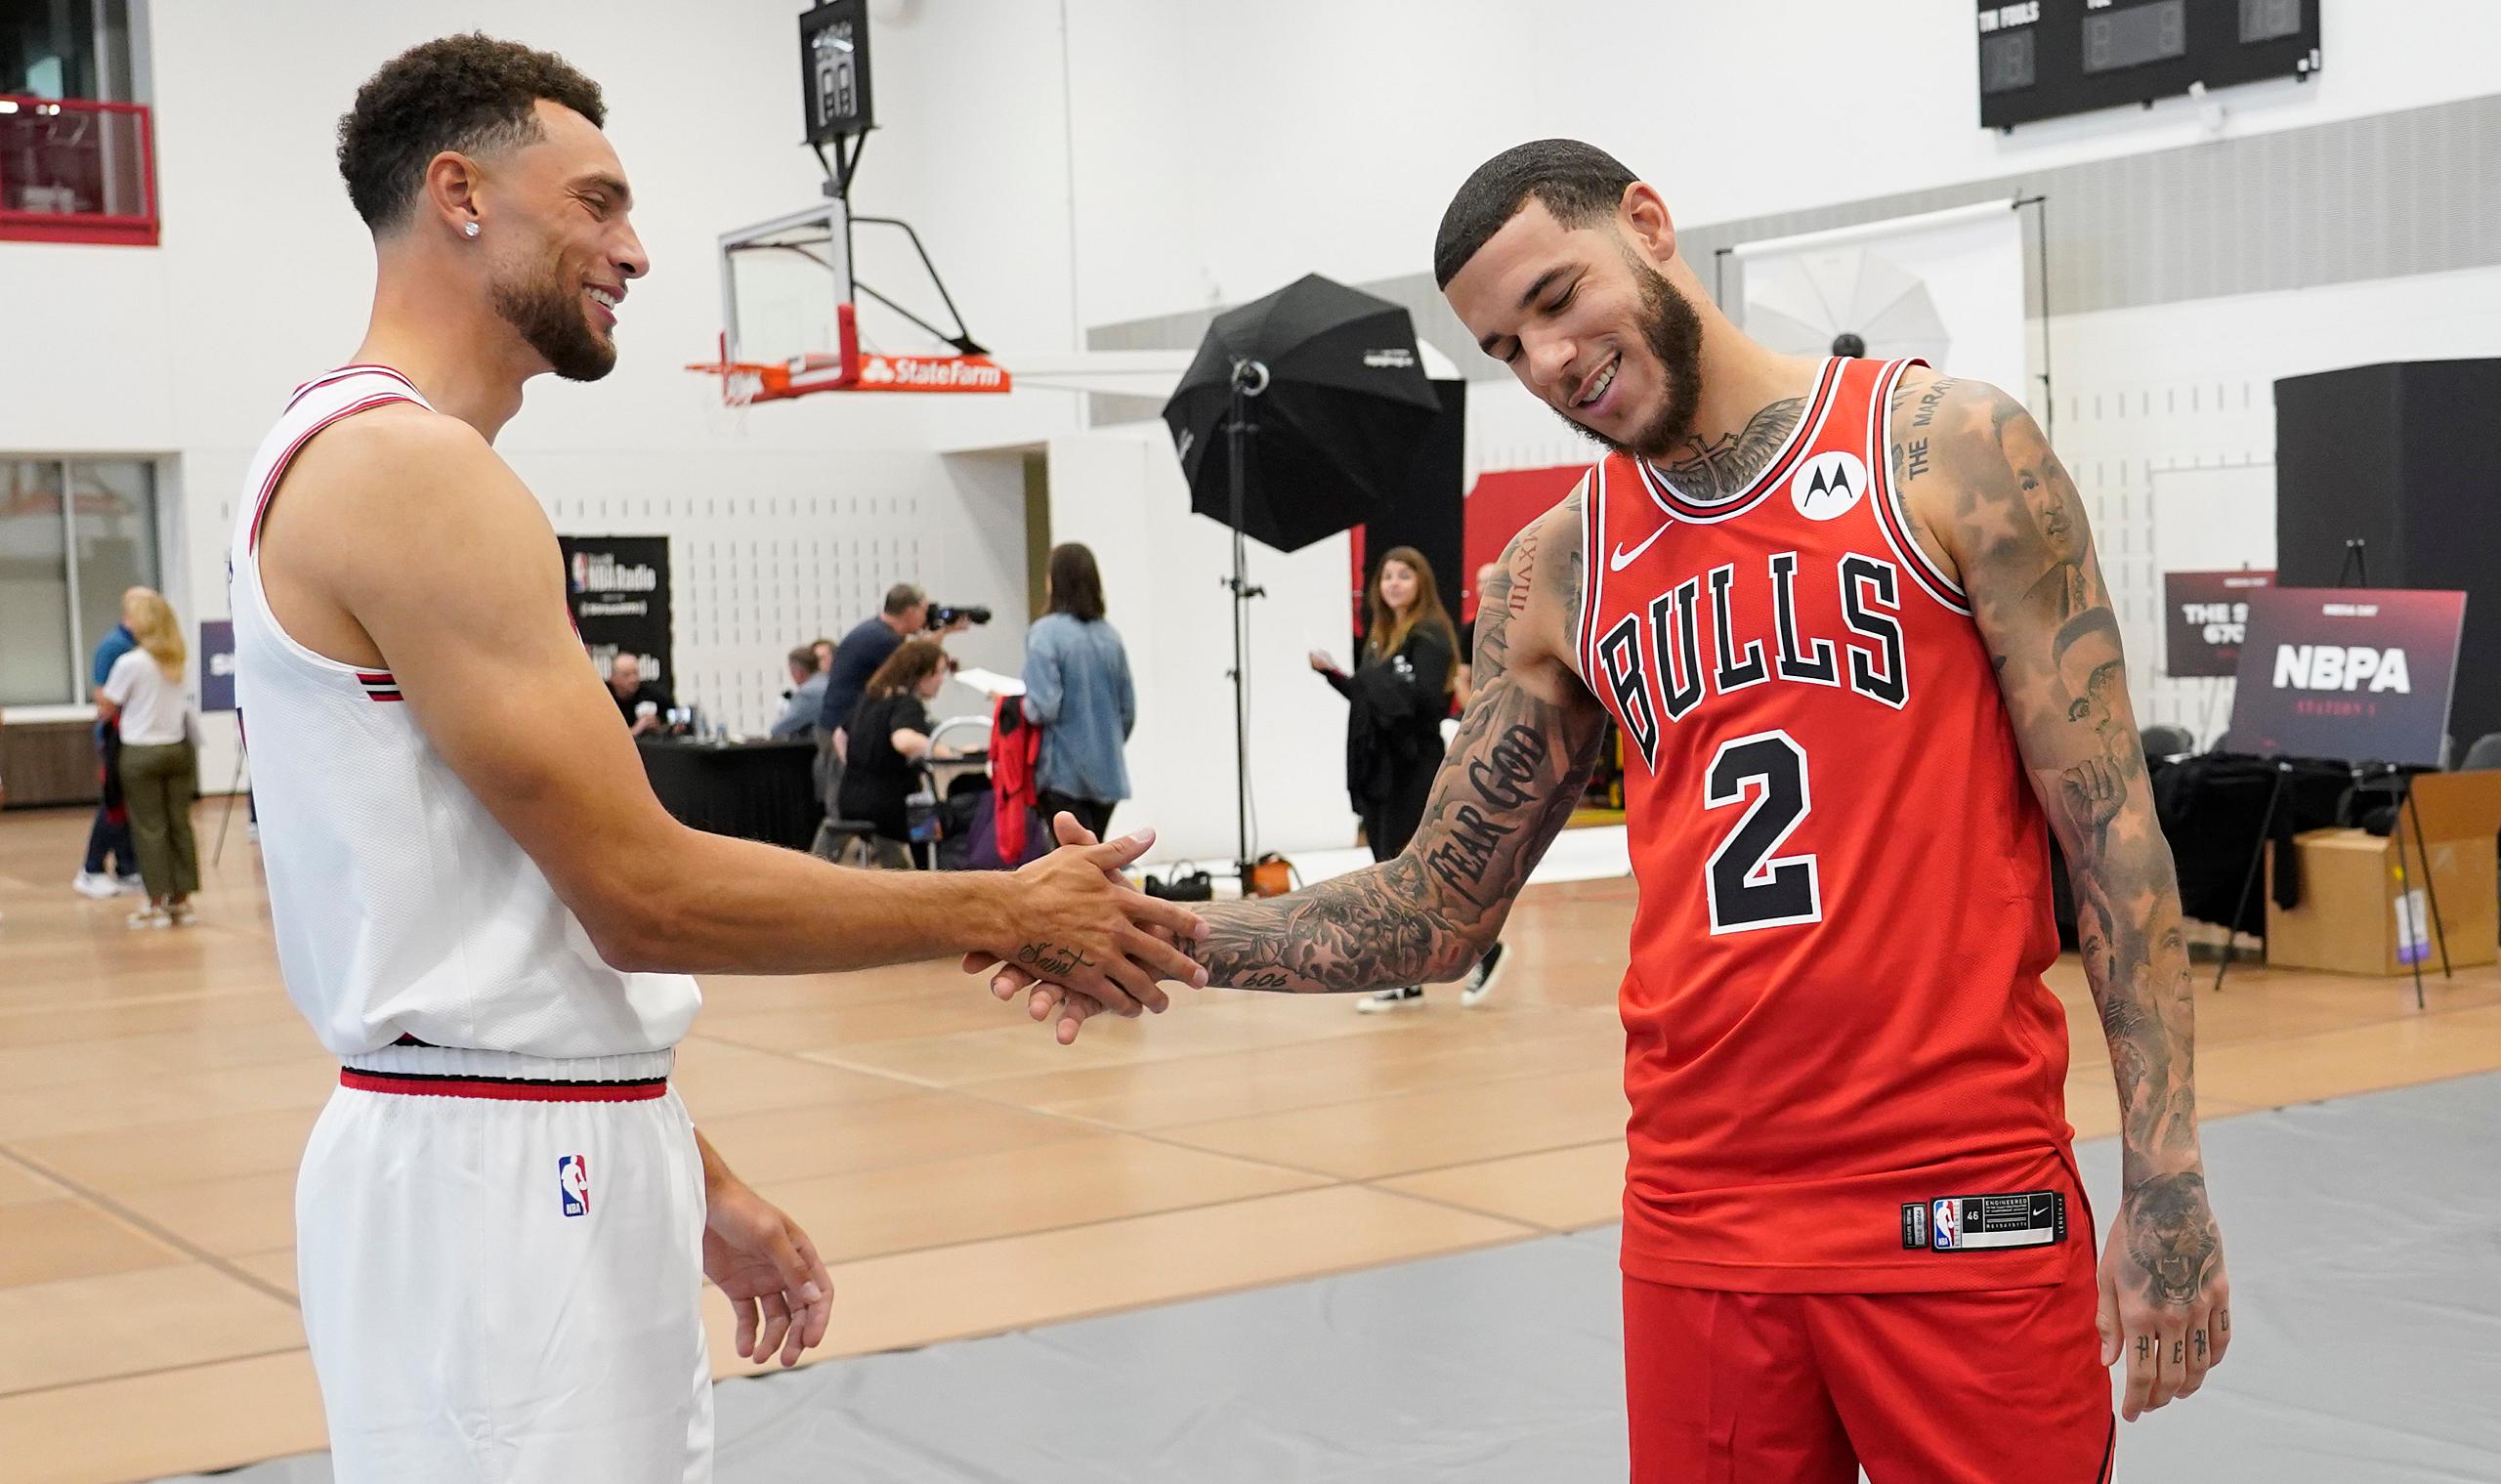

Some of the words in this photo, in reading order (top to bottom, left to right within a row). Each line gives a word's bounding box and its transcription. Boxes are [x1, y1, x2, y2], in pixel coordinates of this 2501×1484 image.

[1909, 437, 1929, 481] THE
[2182, 603, 2229, 624] THE
[1596, 551, 1910, 777] BULLS
[2272, 644, 2410, 695] NBPA
[1704, 729, 1822, 936] 2
[1967, 1210, 1979, 1221] 46
